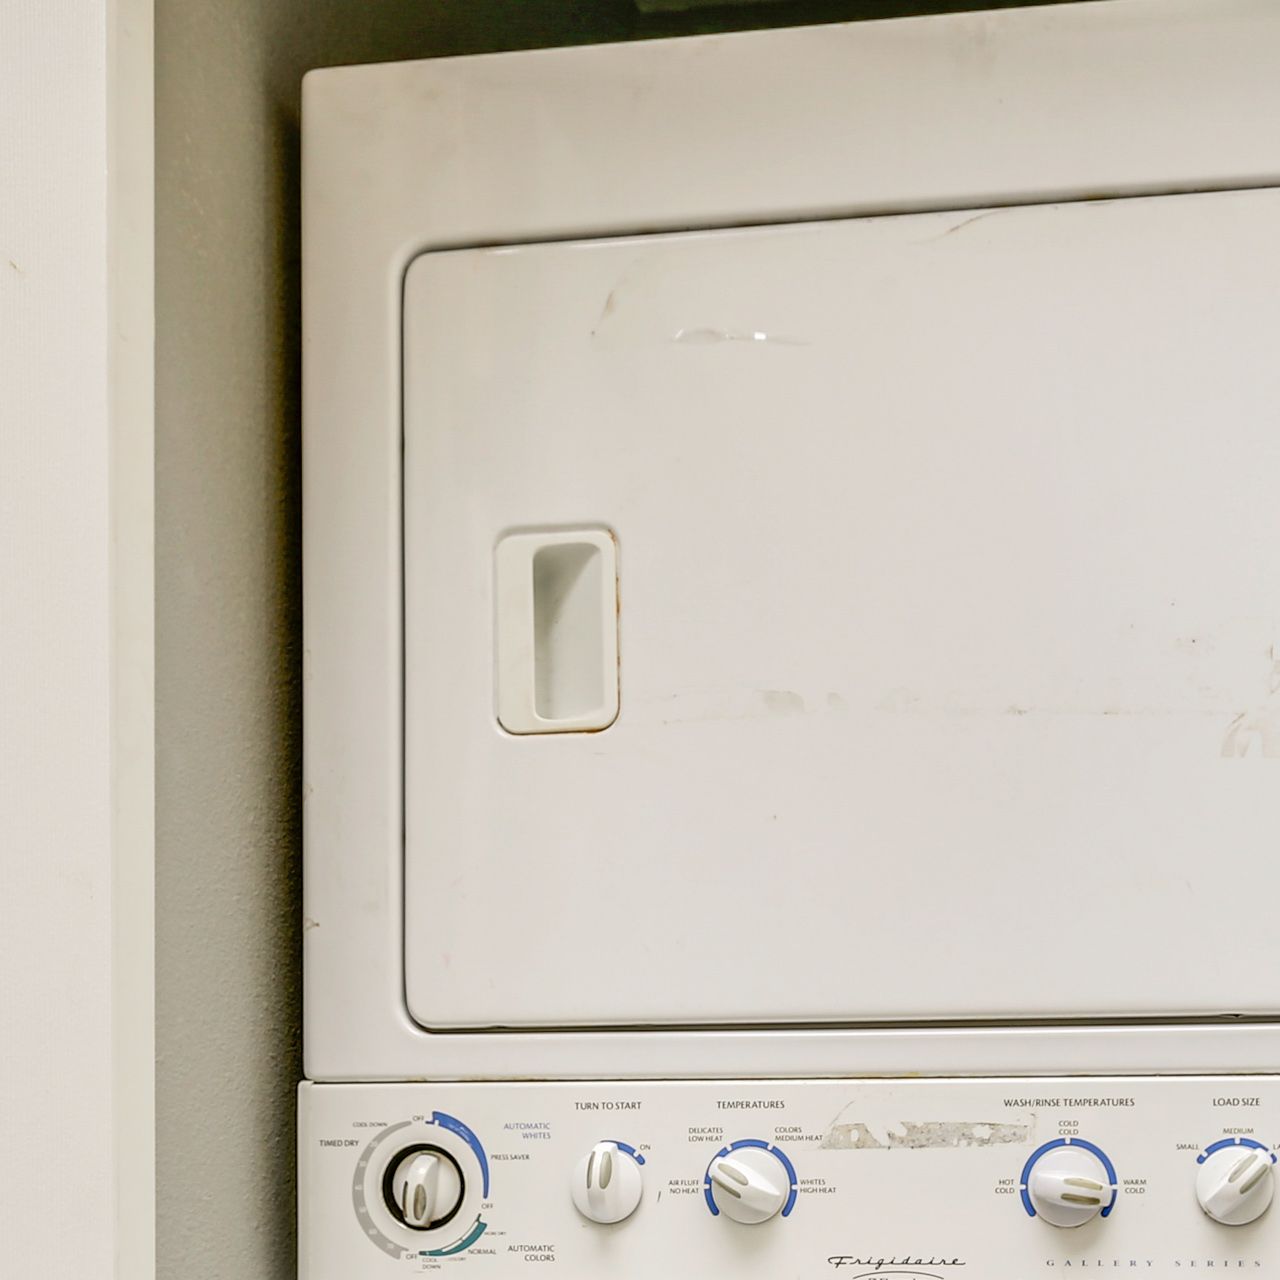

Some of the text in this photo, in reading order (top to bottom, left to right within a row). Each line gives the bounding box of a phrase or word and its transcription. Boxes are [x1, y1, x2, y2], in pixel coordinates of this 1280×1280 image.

[575, 1102, 641, 1110] TURN TO START
[717, 1101, 785, 1109] TEMPERATURES
[1004, 1099, 1135, 1107] WASH/RINSE TEMPERATURES
[1213, 1098, 1260, 1106] LOAD SIZE
[828, 1256, 966, 1270] Frigidaire
